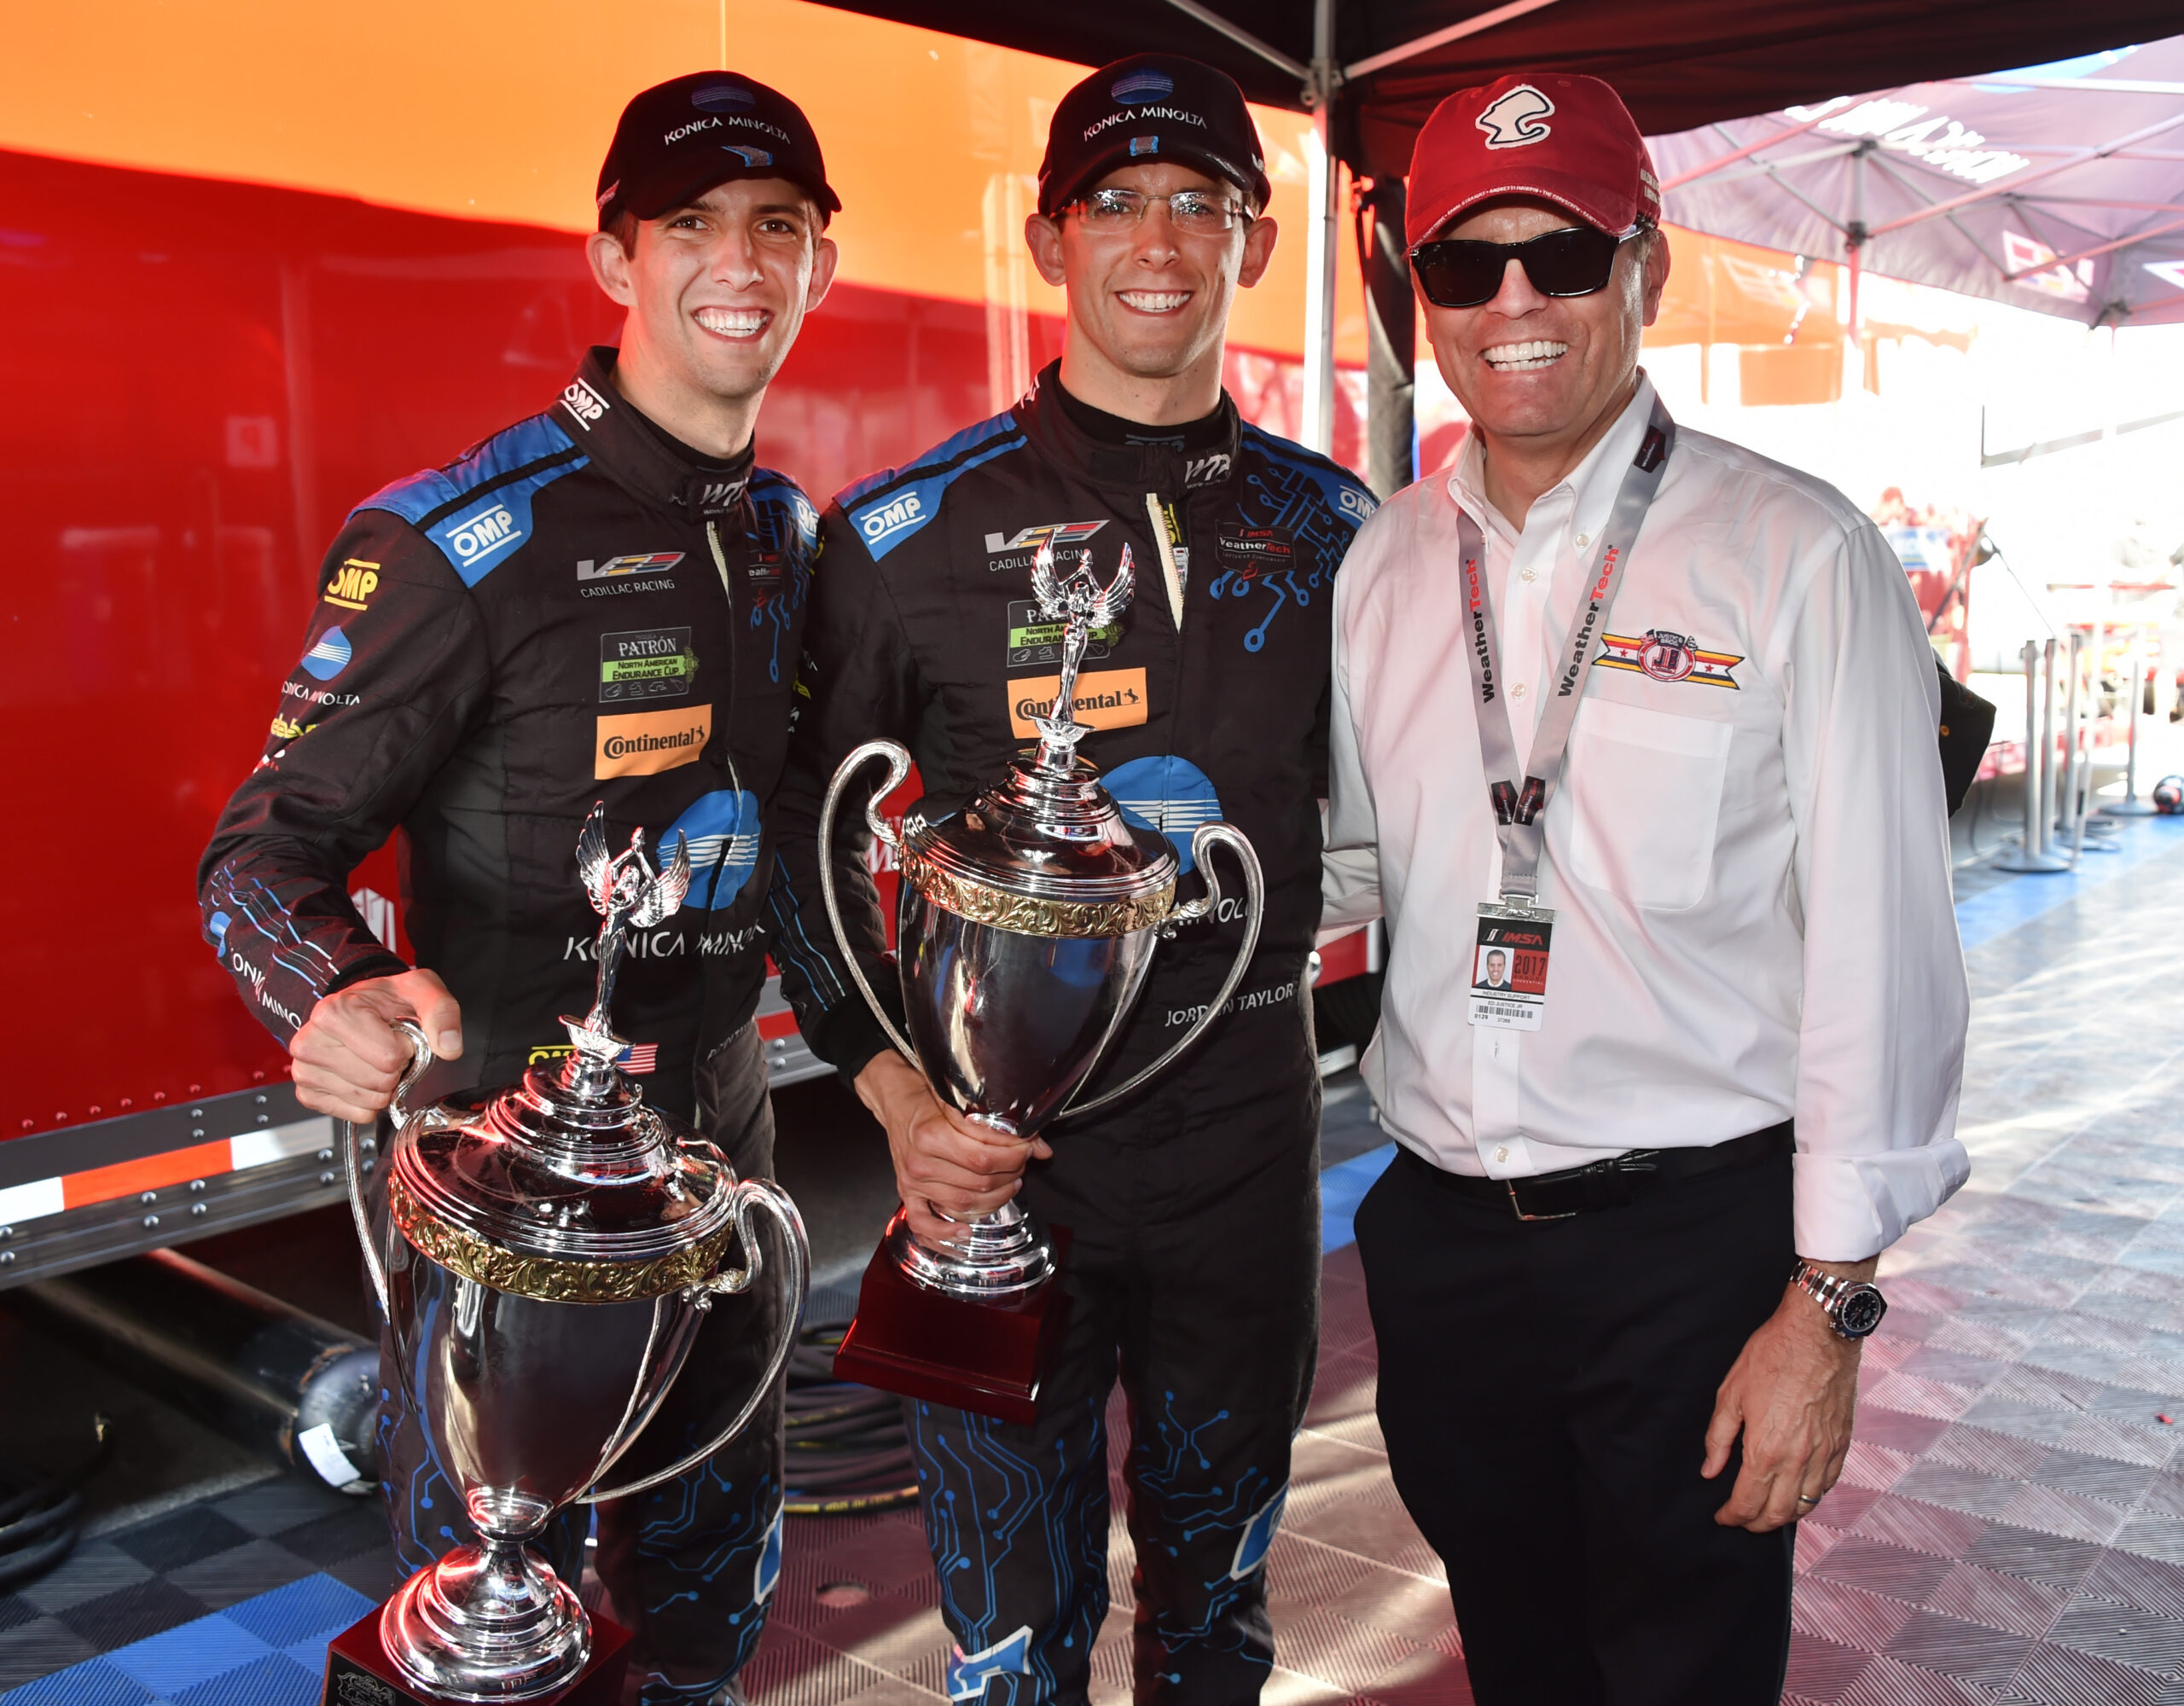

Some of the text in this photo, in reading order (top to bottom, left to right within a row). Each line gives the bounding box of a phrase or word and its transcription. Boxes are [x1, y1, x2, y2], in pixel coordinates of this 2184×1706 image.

[664, 116, 791, 146] KONICA MINOLTA
[1083, 107, 1207, 142] KONICA MINOLTA
[564, 383, 603, 421] OMP
[863, 496, 922, 537] OMP
[1339, 490, 1374, 519] OM
[452, 509, 514, 558] OMP
[989, 554, 1037, 572] CADILLA
[580, 578, 675, 599] CADILLAC RACING
[1466, 559, 1495, 704] WeatherTech
[1558, 546, 1620, 699] WeatherTech
[618, 636, 677, 657] PATRÓN
[1020, 634, 1064, 647] ENDURAN
[613, 668, 662, 681] ENDURANCE
[618, 658, 677, 670] NORTH AMERICAN
[1015, 690, 1122, 722] Contental
[603, 728, 695, 760] Continental
[1502, 931, 1544, 946] IMSA
[1514, 955, 1547, 977] 2017
[1165, 983, 1294, 1027] JORDN TAYLOR
